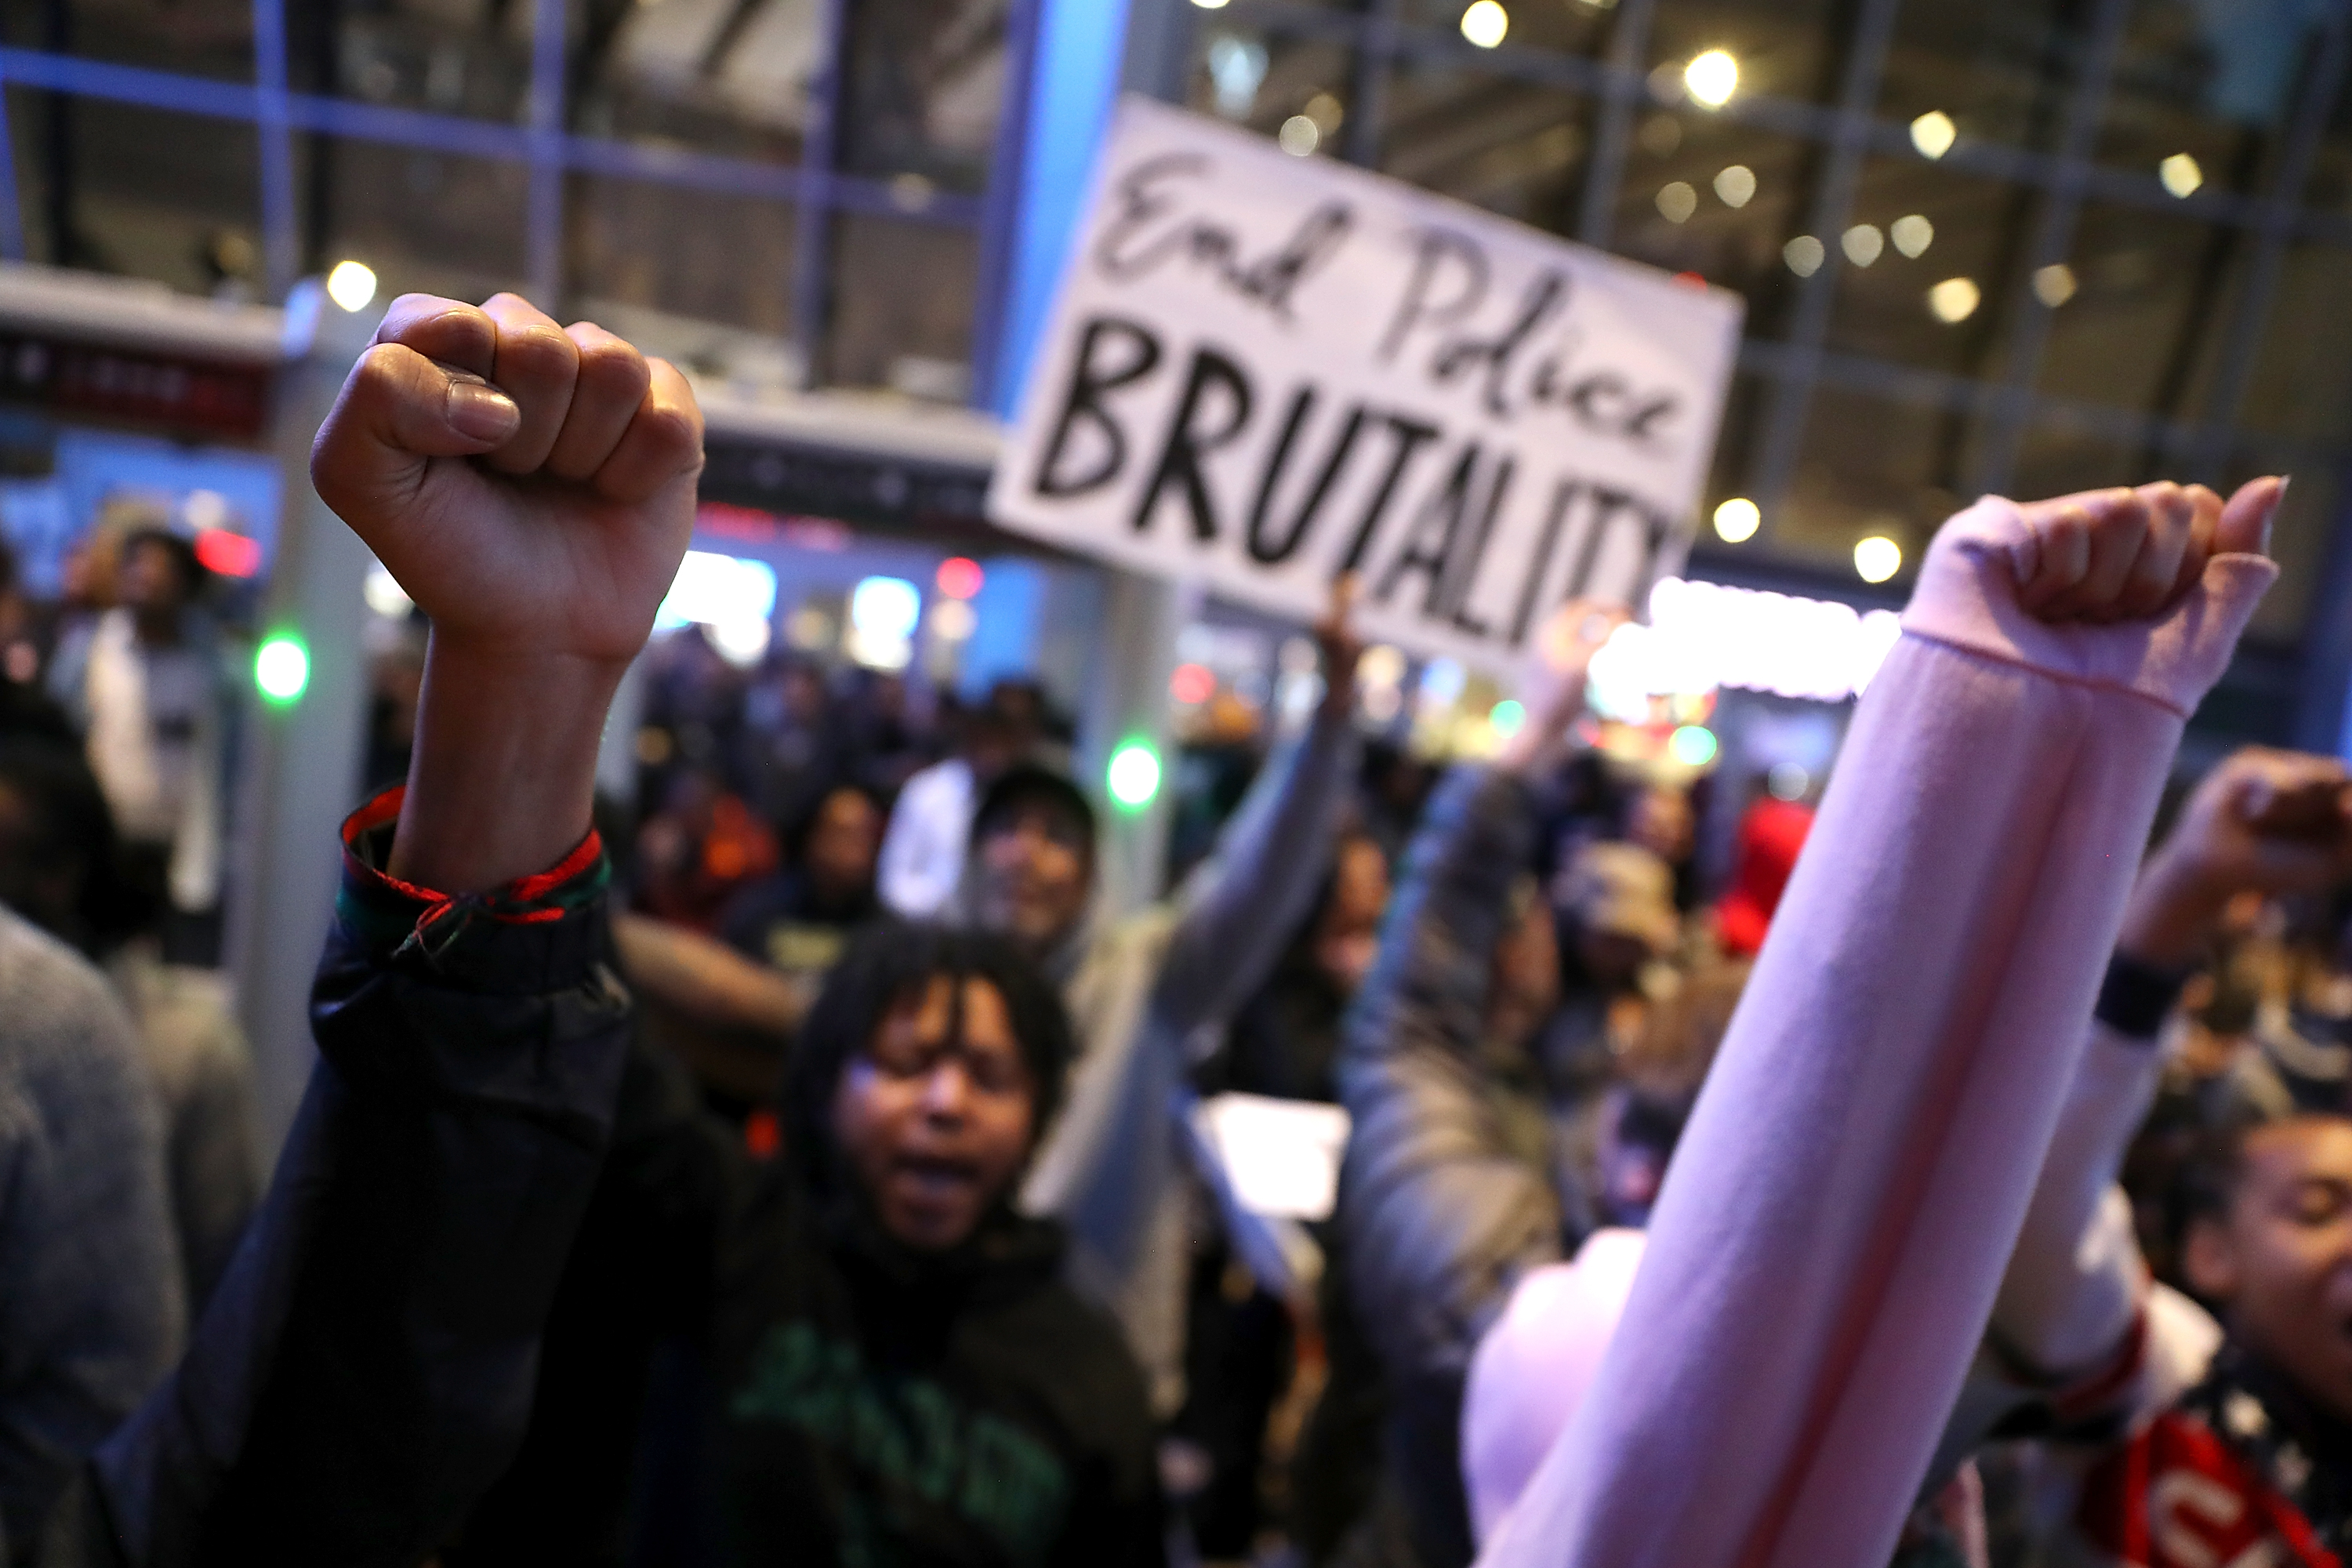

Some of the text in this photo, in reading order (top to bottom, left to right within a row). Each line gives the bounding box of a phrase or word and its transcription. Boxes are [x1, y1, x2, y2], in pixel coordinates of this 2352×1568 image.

[1095, 149, 1686, 444] End Police
[1031, 315, 1671, 652] BRUTALITY
